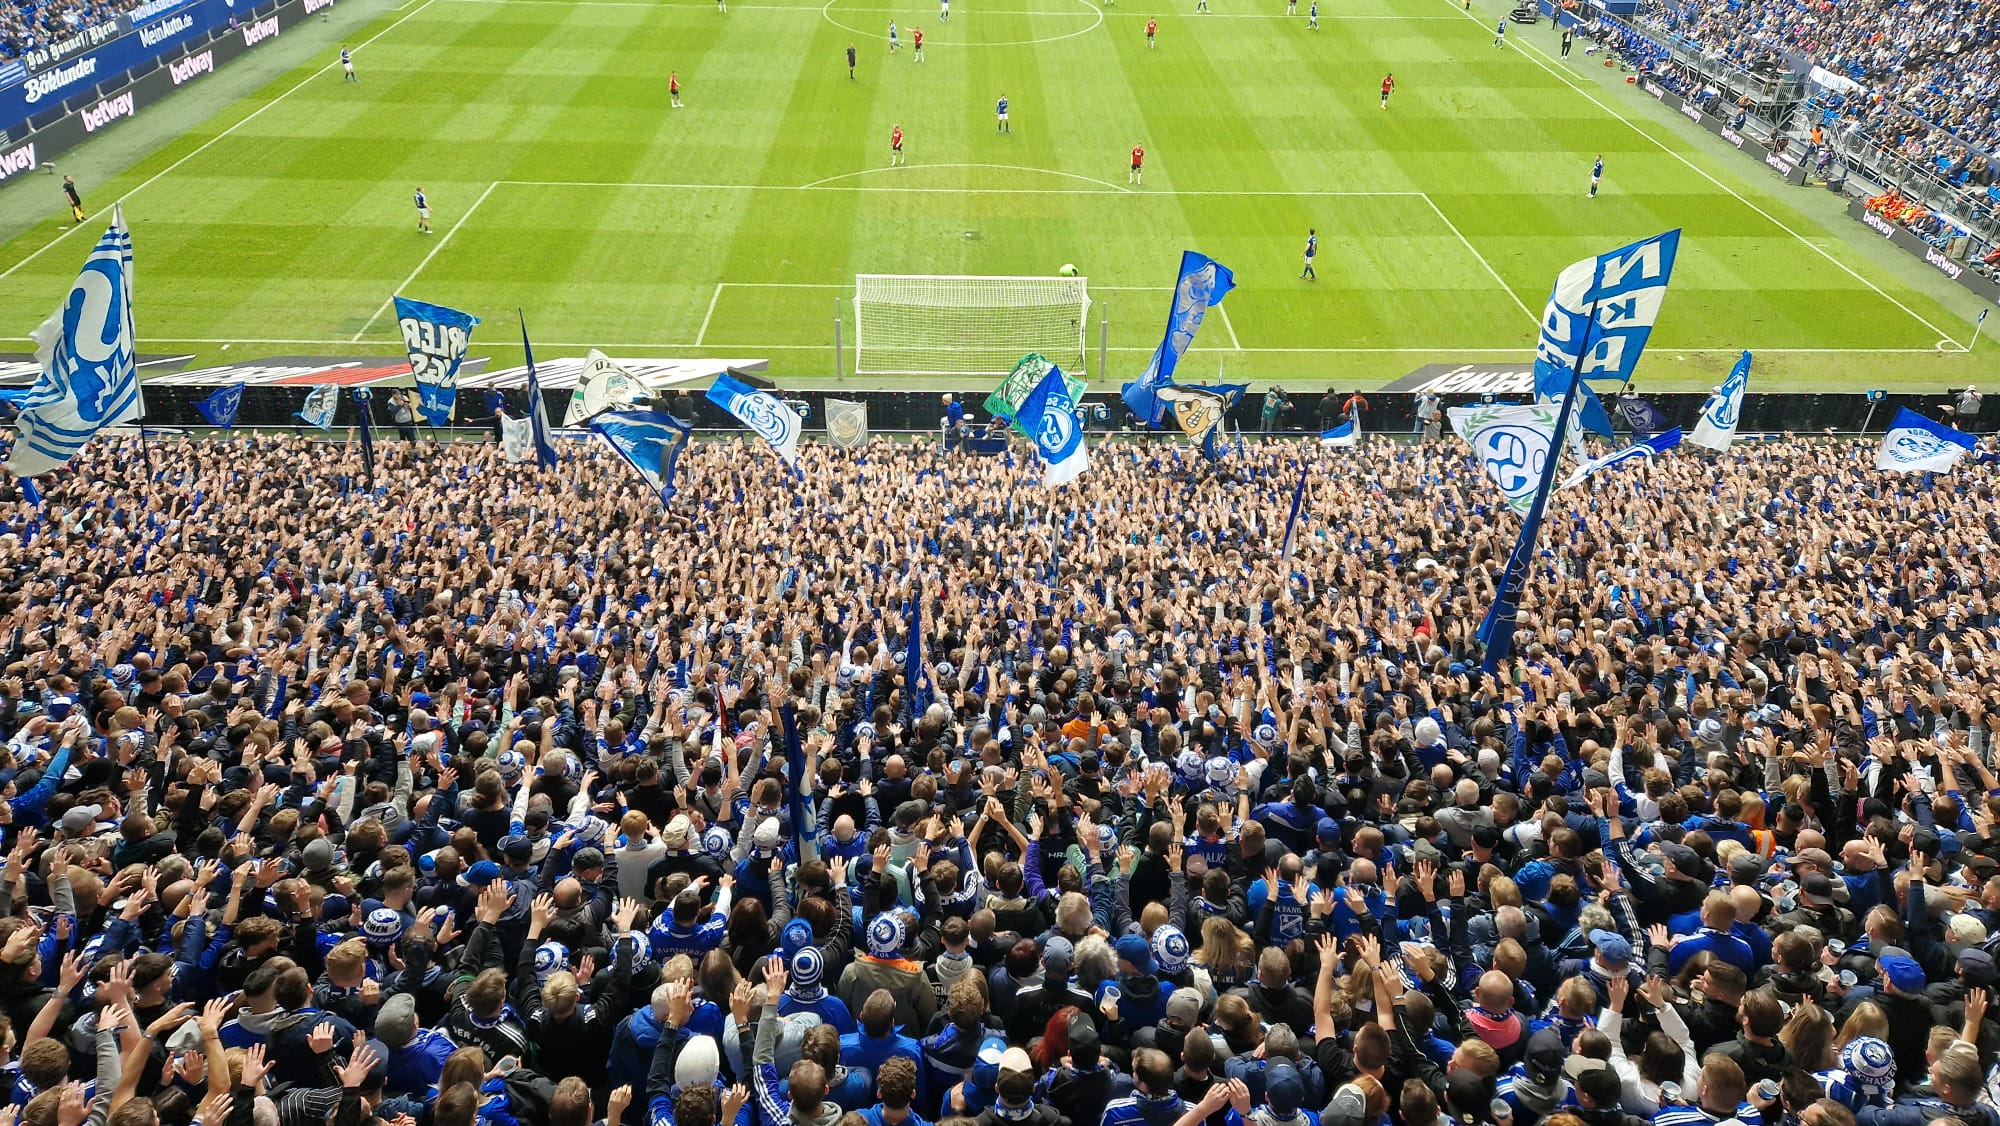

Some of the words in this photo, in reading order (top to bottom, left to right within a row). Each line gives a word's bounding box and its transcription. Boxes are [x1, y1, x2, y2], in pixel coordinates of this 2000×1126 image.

[138, 14, 193, 48] MeinAuto.de
[243, 15, 279, 46] betway
[24, 57, 96, 103] Böklunder
[169, 49, 213, 85] betway
[1645, 80, 1664, 100] betway
[81, 91, 134, 132] betway
[1681, 102, 1702, 123] betway
[1721, 125, 1744, 149] betway
[1765, 151, 1792, 176] betway
[1863, 209, 1896, 239] betway
[1925, 247, 1963, 280] betway
